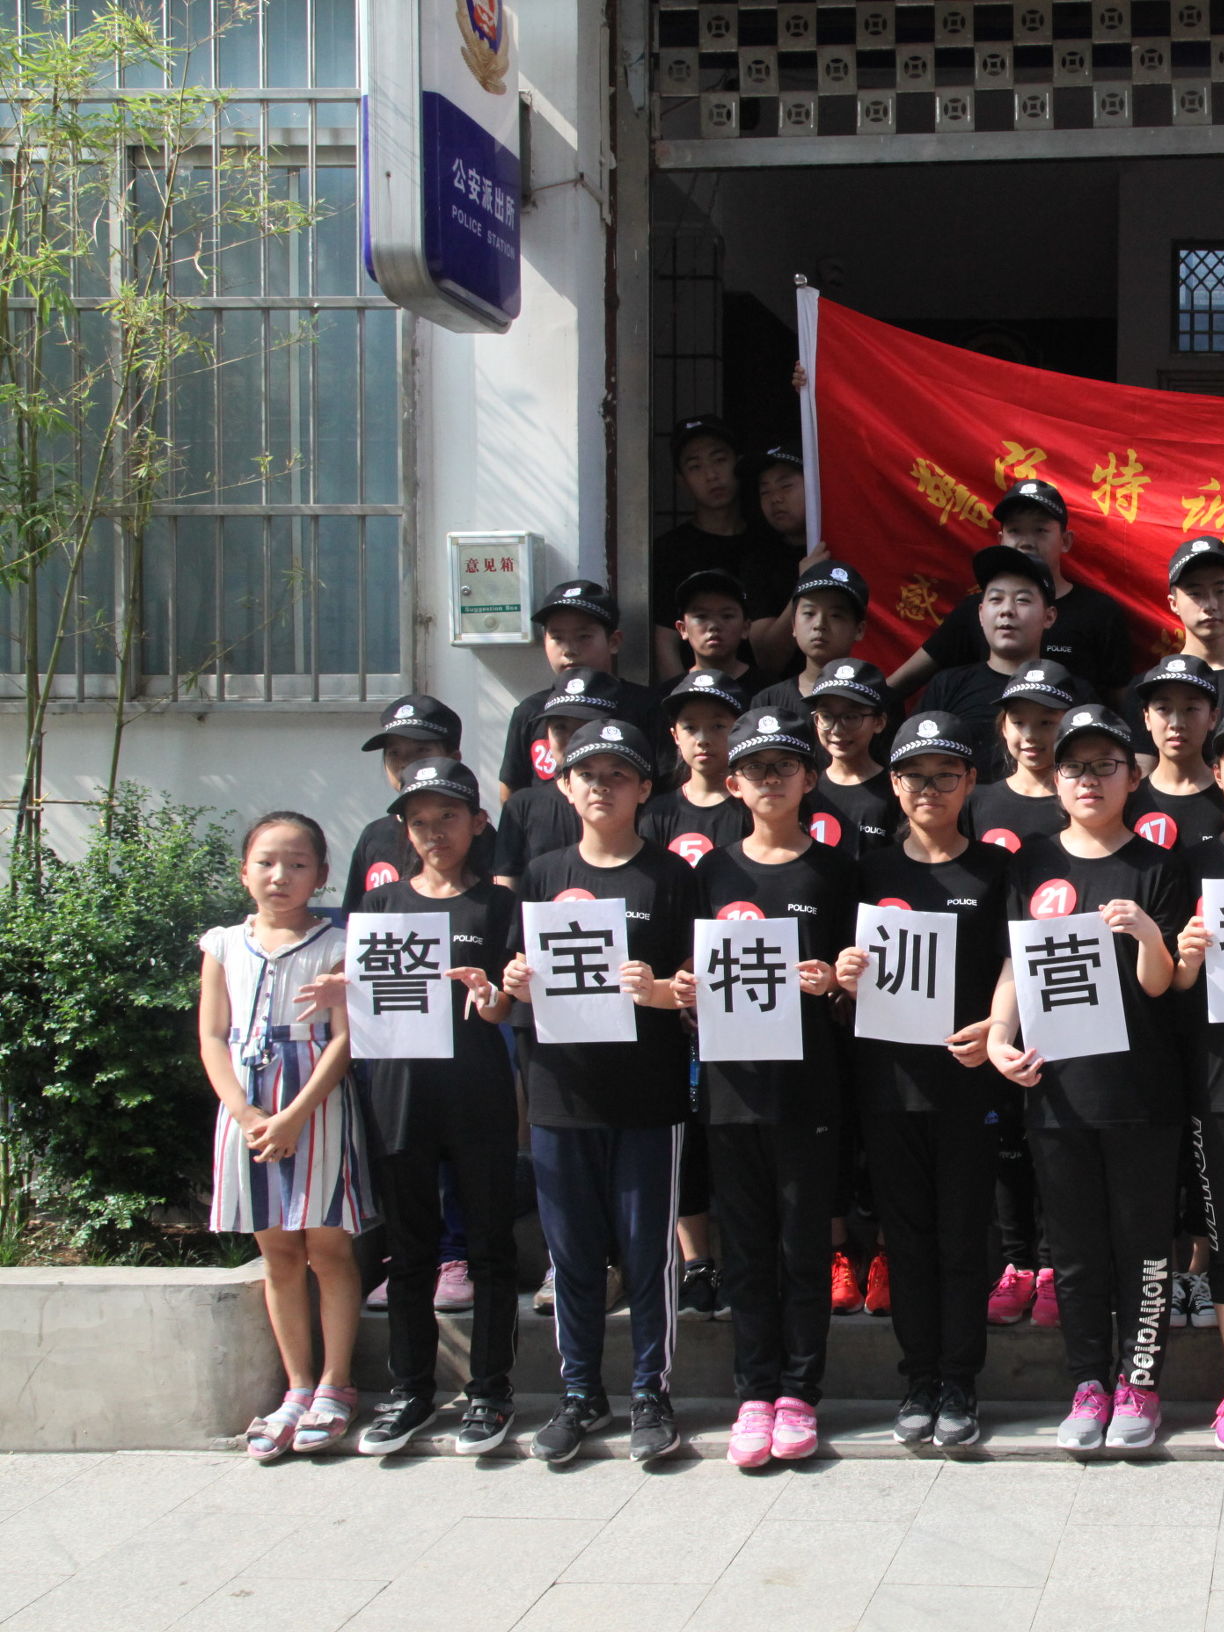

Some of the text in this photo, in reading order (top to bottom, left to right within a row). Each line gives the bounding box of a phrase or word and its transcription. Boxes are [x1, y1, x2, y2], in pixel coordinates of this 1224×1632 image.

[452, 158, 515, 231] 公安派出所
[452, 204, 516, 260] POLICE STATION
[465, 556, 514, 574] 意见箱
[1046, 645, 1073, 653] POLICE
[534, 745, 557, 774] 25
[859, 825, 887, 837] POLICE
[1140, 817, 1166, 846] 17
[679, 839, 703, 868] 5
[787, 903, 818, 915] POLICE
[946, 898, 978, 907] POLICE
[1037, 886, 1067, 914] 21
[624, 910, 651, 921] OLICE
[453, 935, 484, 946] POLICE
[538, 920, 620, 996] 宝
[868, 925, 938, 999] 训
[357, 931, 441, 1015] 警
[708, 937, 787, 1013] 特
[1025, 933, 1101, 1013] 营
[1129, 1257, 1168, 1386] Motivated
